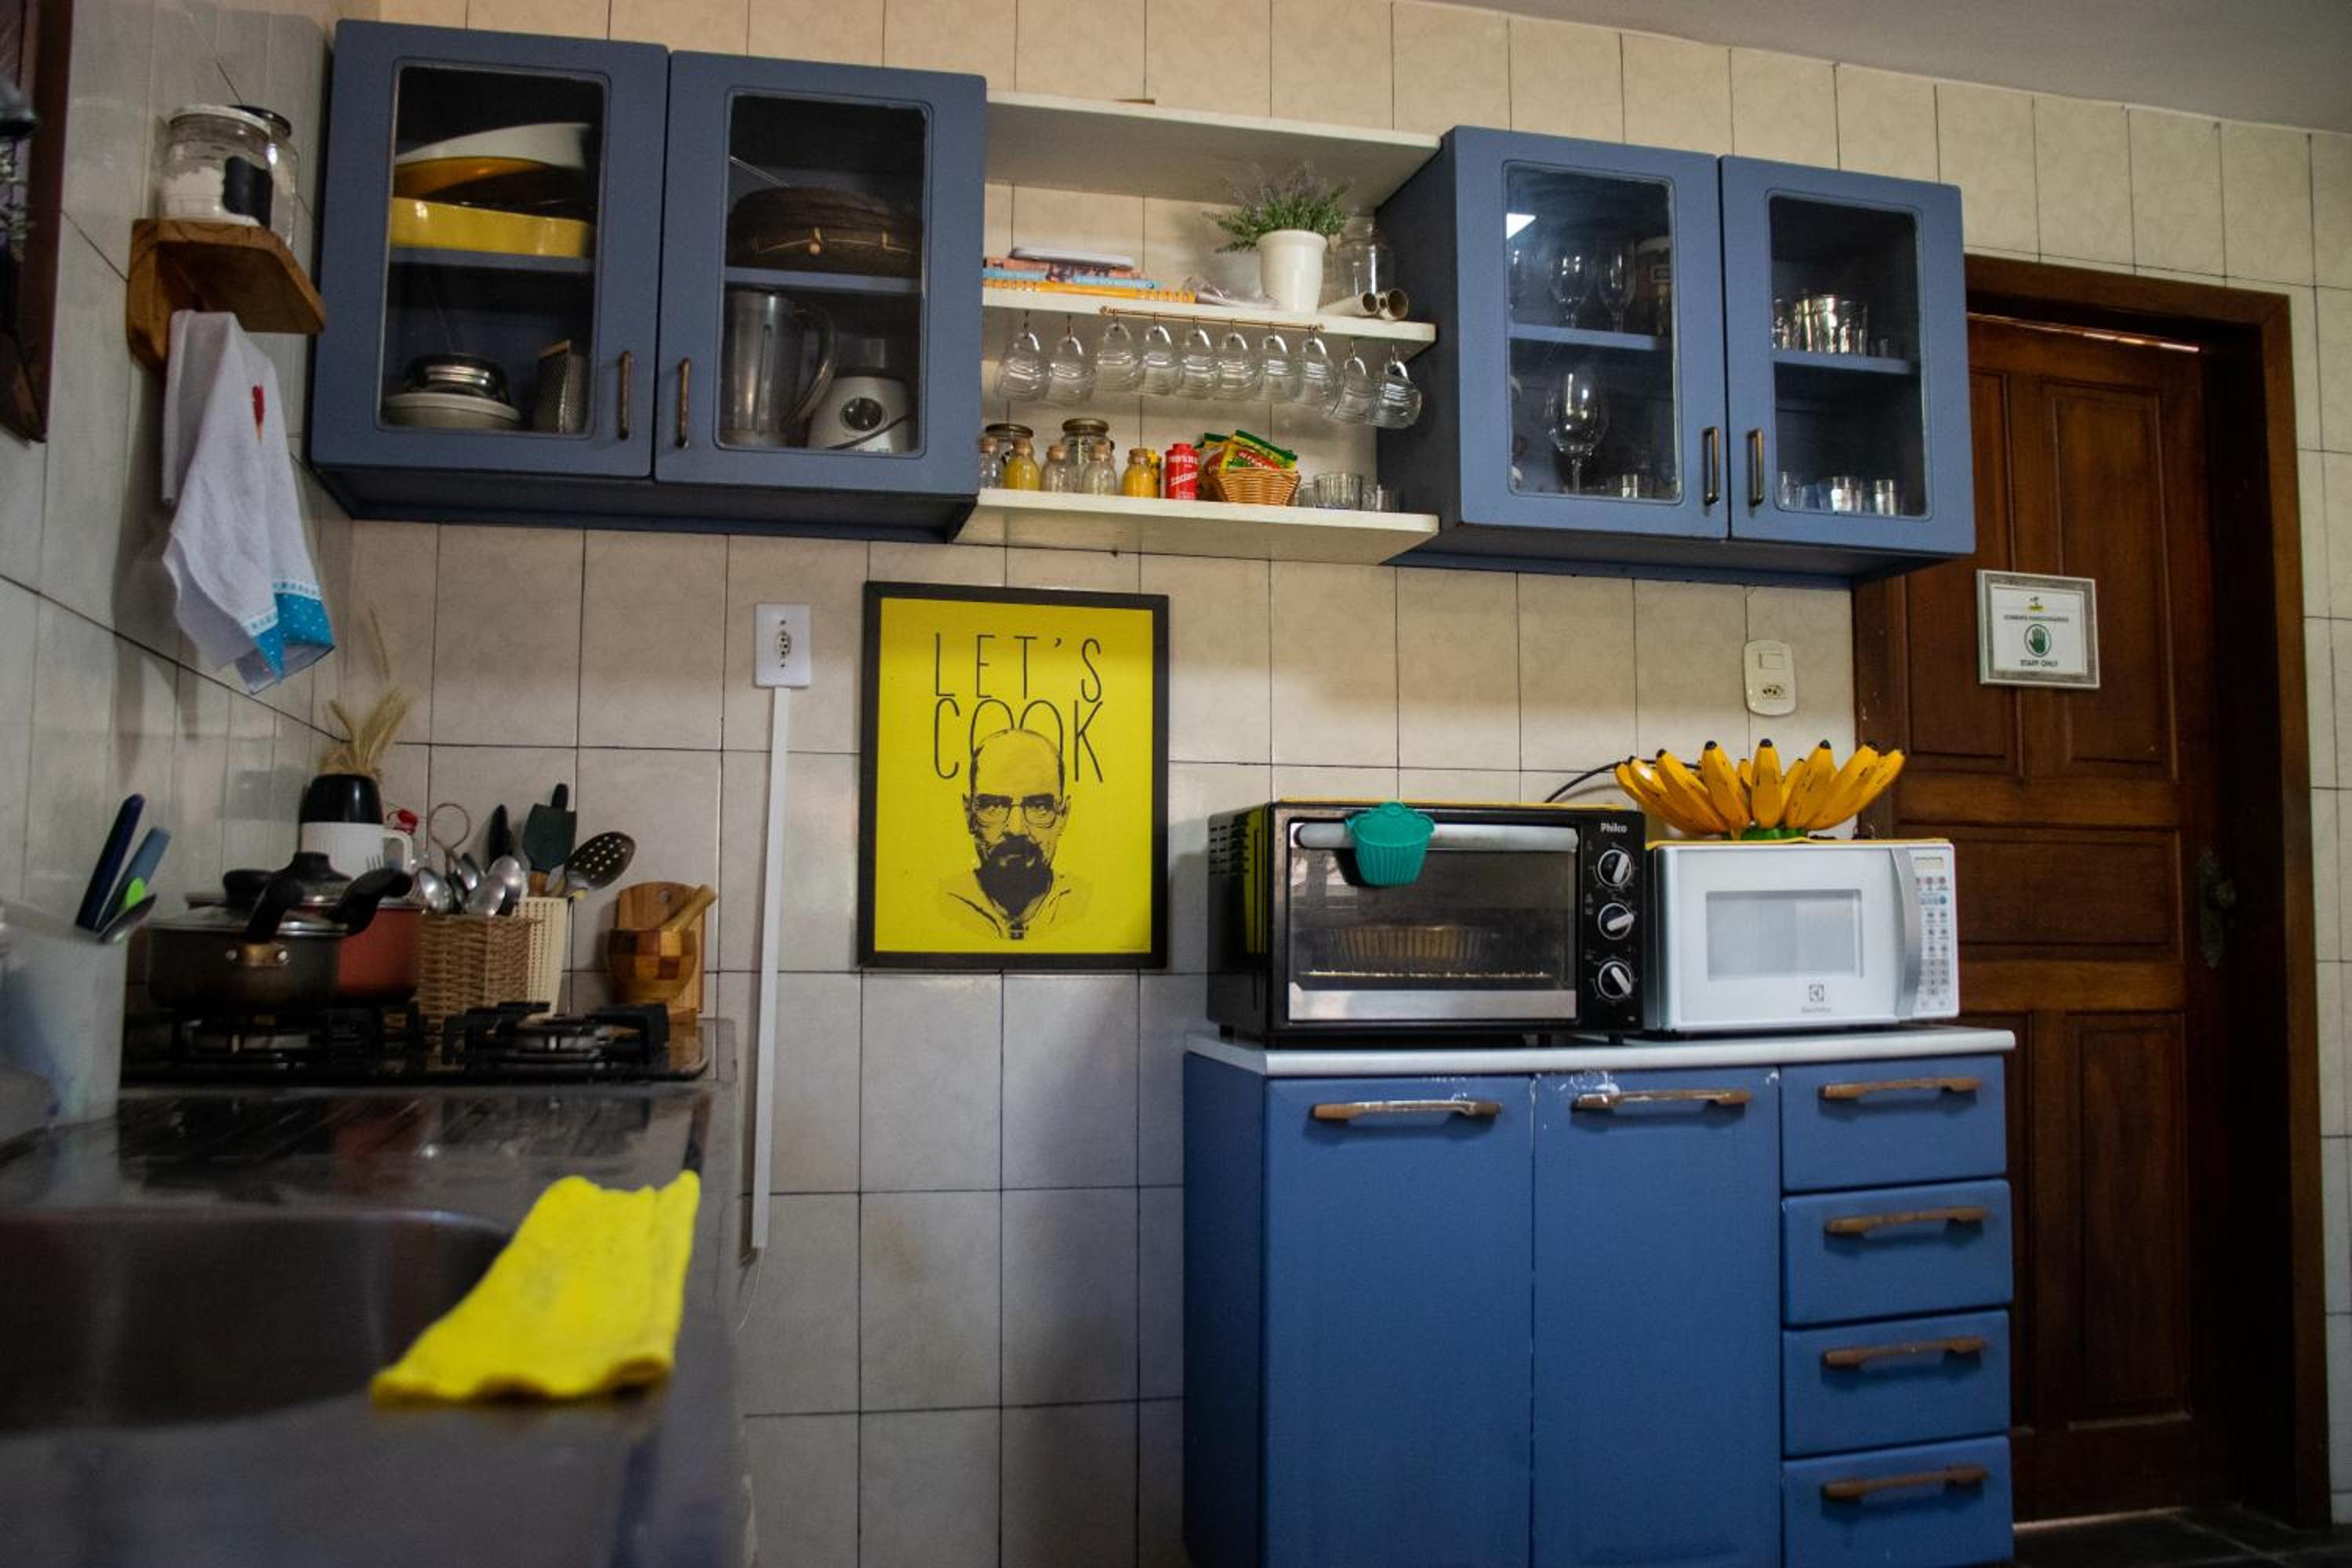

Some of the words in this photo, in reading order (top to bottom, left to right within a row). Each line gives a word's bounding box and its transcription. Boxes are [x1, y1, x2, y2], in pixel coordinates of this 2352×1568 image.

[935, 632, 1102, 703] LET'S
[934, 697, 1104, 783] COOK
[1600, 822, 1628, 833] Philco
